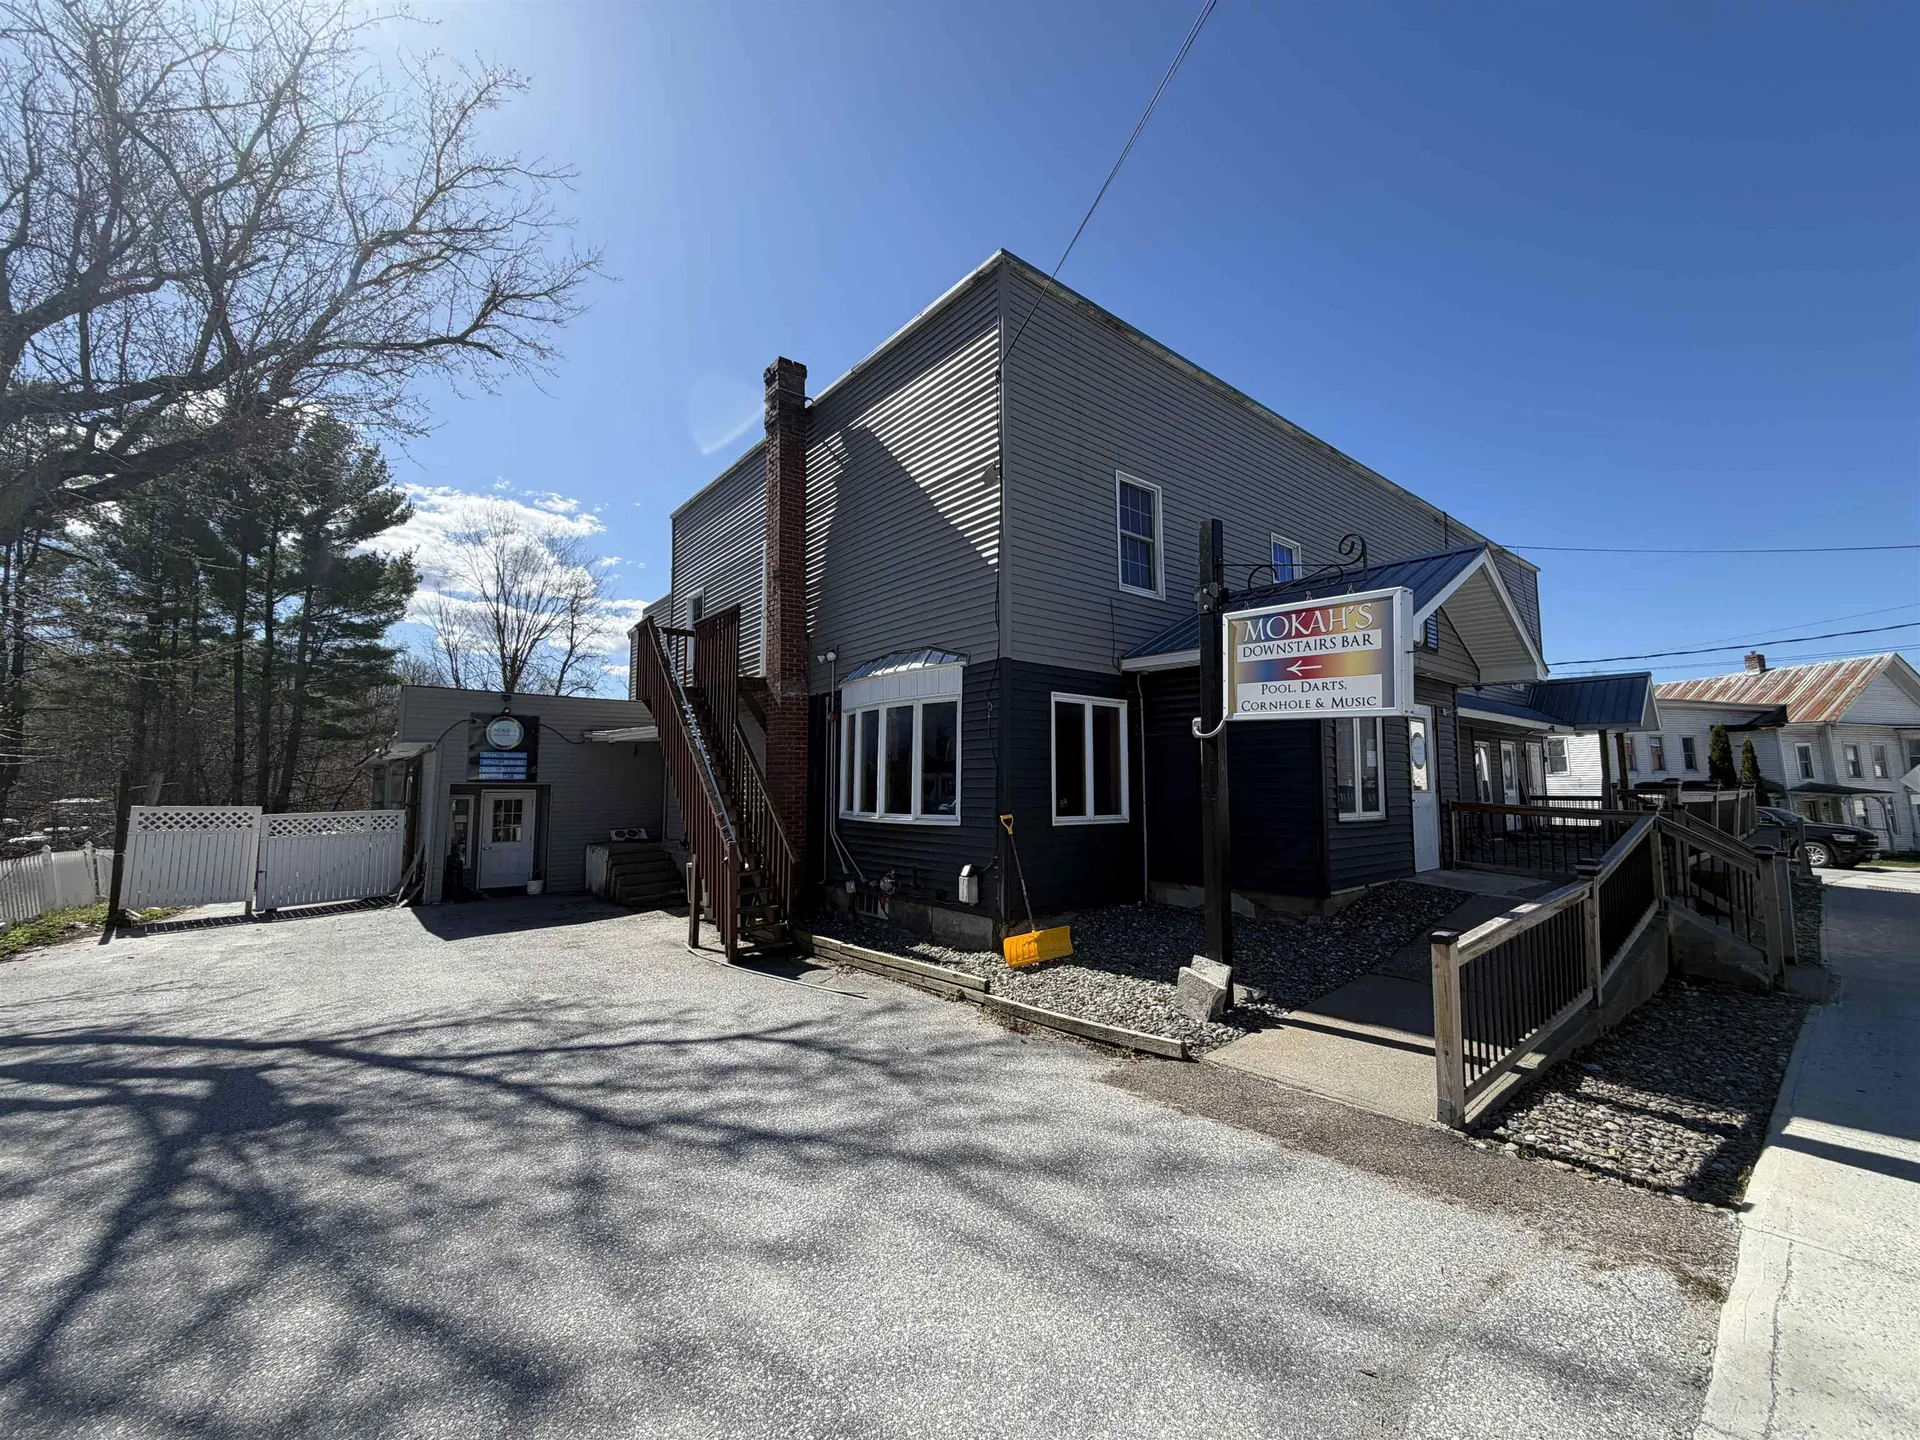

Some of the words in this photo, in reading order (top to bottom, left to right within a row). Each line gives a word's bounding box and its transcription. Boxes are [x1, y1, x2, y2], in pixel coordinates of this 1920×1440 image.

[1243, 603, 1374, 642] MOKAH'S
[1243, 637, 1336, 658] DOWNSTAIRS
[1341, 633, 1374, 648] BAR
[1301, 680, 1347, 693] DARTS,
[1241, 700, 1311, 712] CORNHOLE
[1315, 697, 1325, 708] &
[1331, 696, 1377, 709] MUSIC
